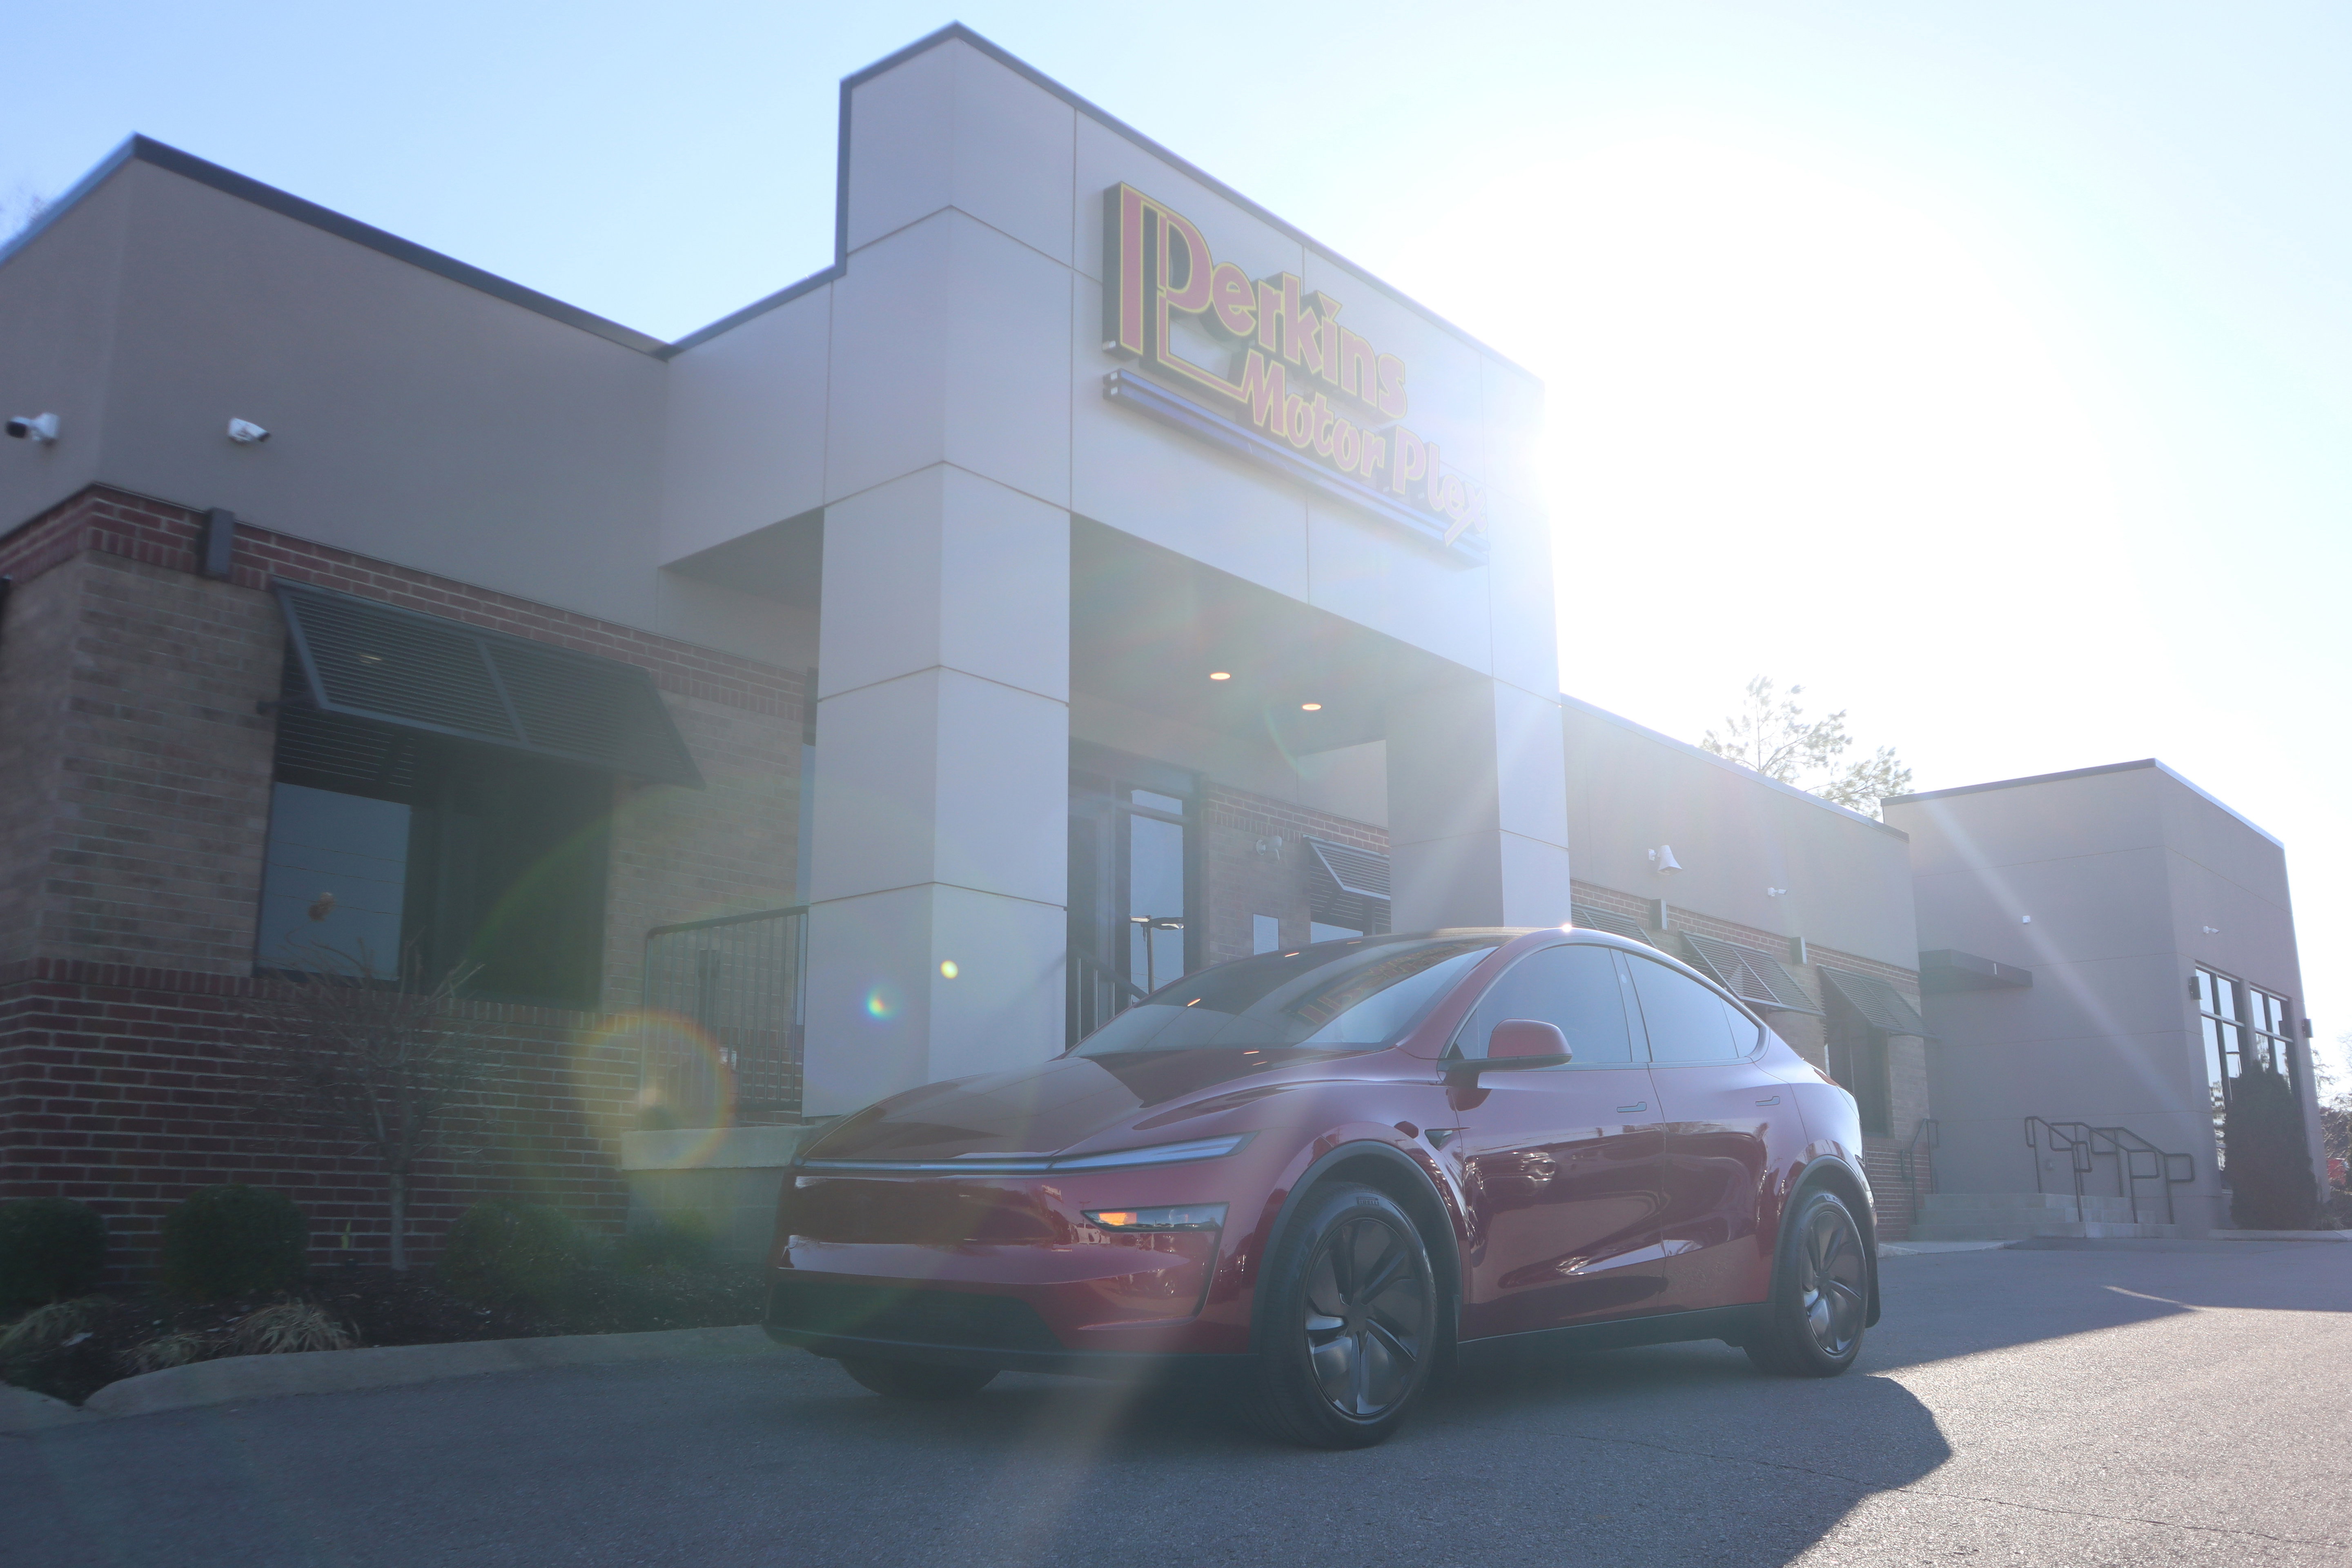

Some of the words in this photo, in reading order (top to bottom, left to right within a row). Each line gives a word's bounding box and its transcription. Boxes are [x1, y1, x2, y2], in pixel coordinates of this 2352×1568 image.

[1120, 181, 1407, 419] Perkins
[1240, 347, 1386, 478] Motor
[1392, 424, 1488, 547] Plex
[1356, 1196, 1379, 1206] PIRELLI
